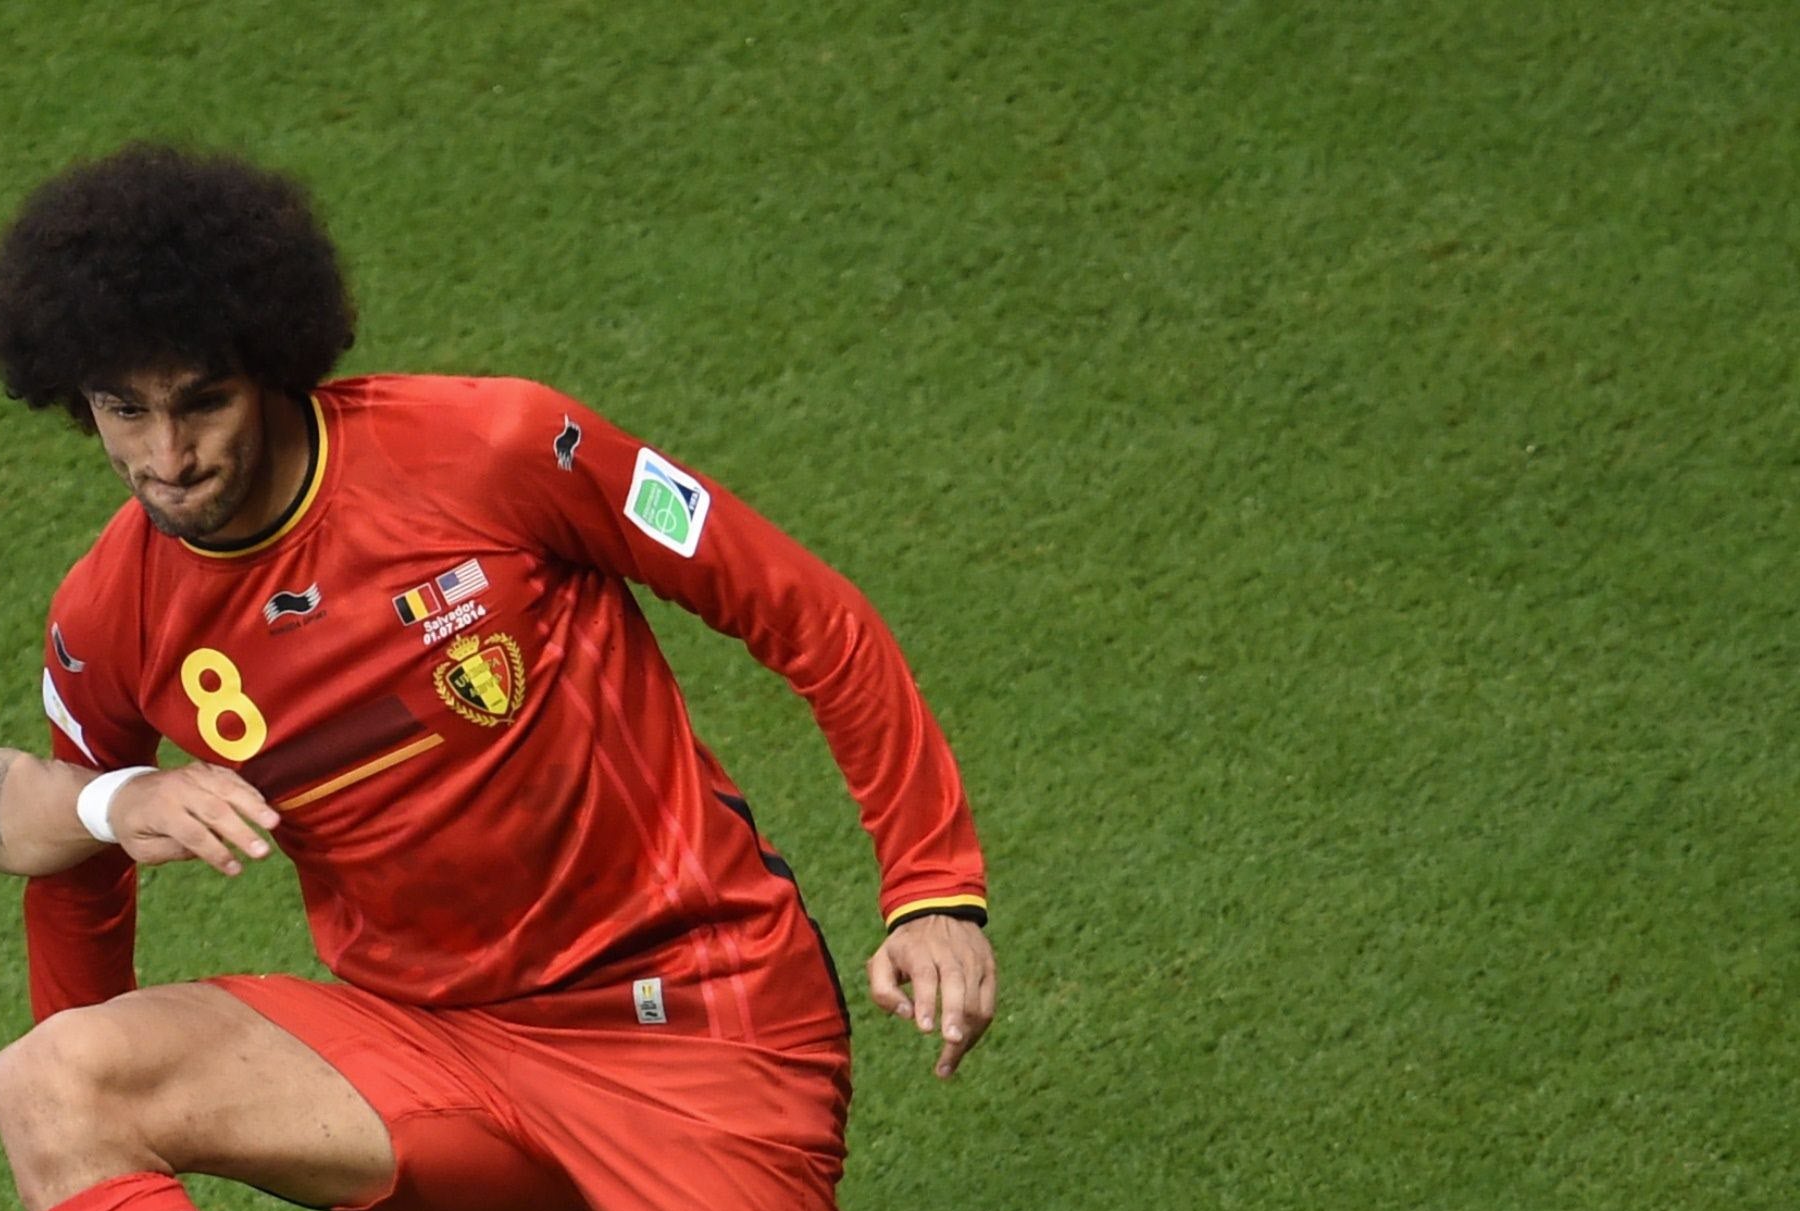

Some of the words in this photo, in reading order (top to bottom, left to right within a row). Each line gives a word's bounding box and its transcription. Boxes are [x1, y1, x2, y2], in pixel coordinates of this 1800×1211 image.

[423, 600, 475, 632] Salvador
[423, 604, 486, 645] 01.07.2014
[181, 647, 267, 762] 8
